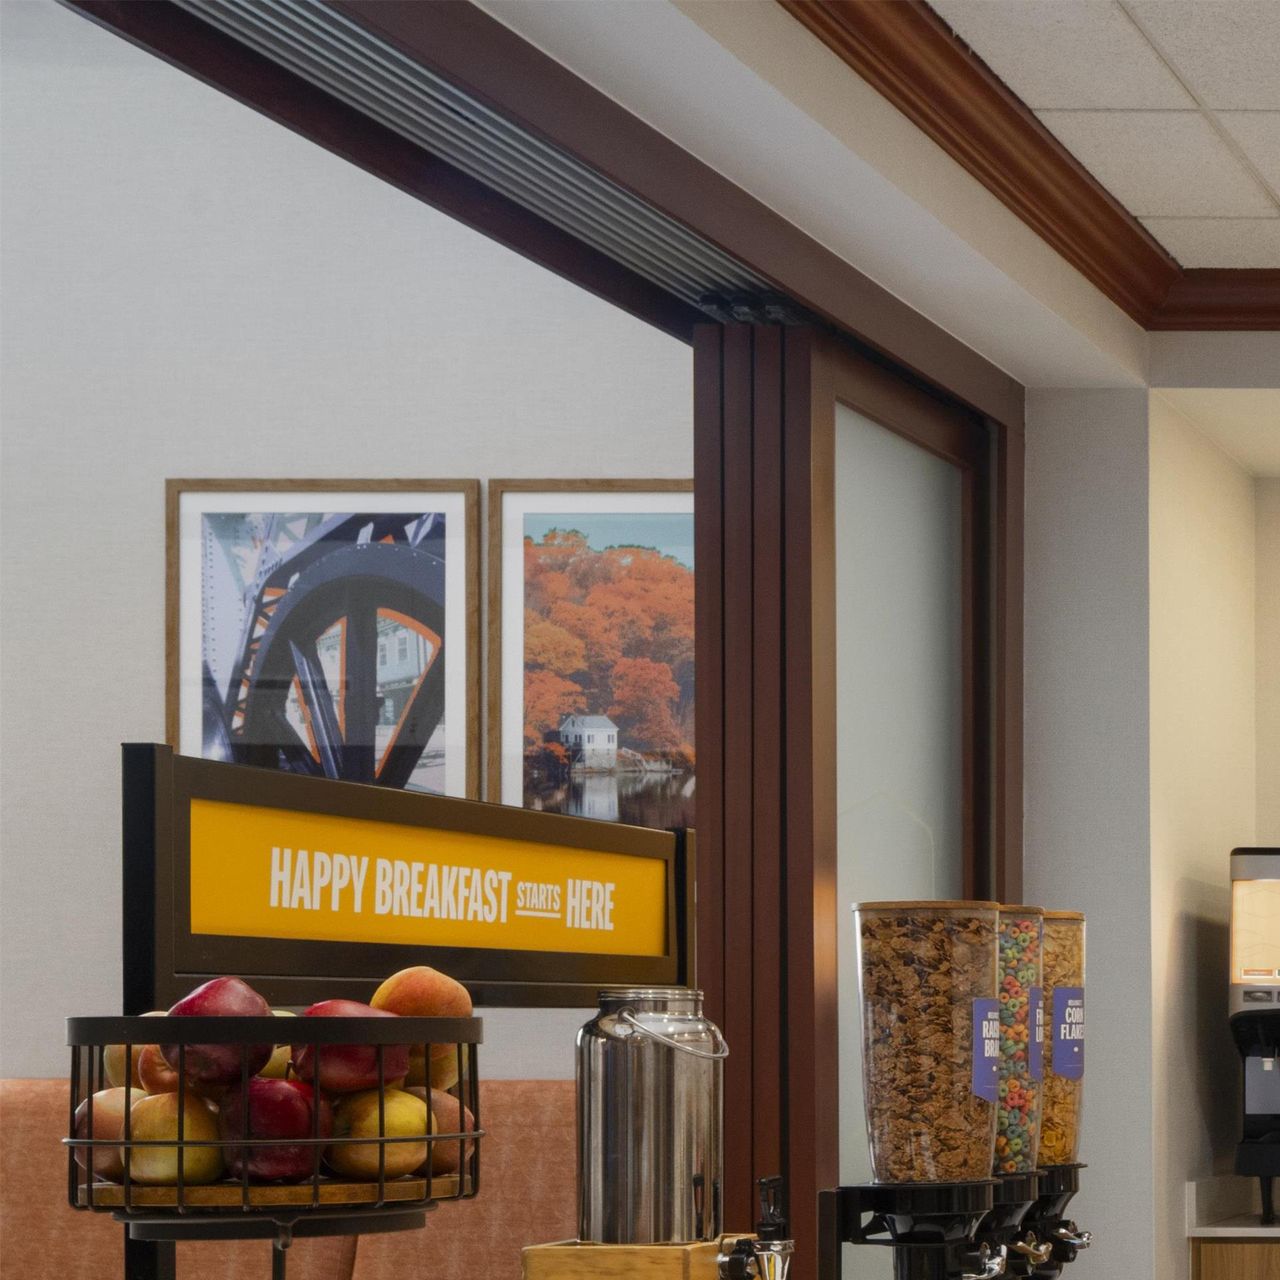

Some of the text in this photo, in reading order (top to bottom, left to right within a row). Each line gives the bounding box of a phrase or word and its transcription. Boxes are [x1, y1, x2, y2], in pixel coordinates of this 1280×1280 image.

[269, 847, 615, 931] HAPPY BREAKFAST STARTS HERE
